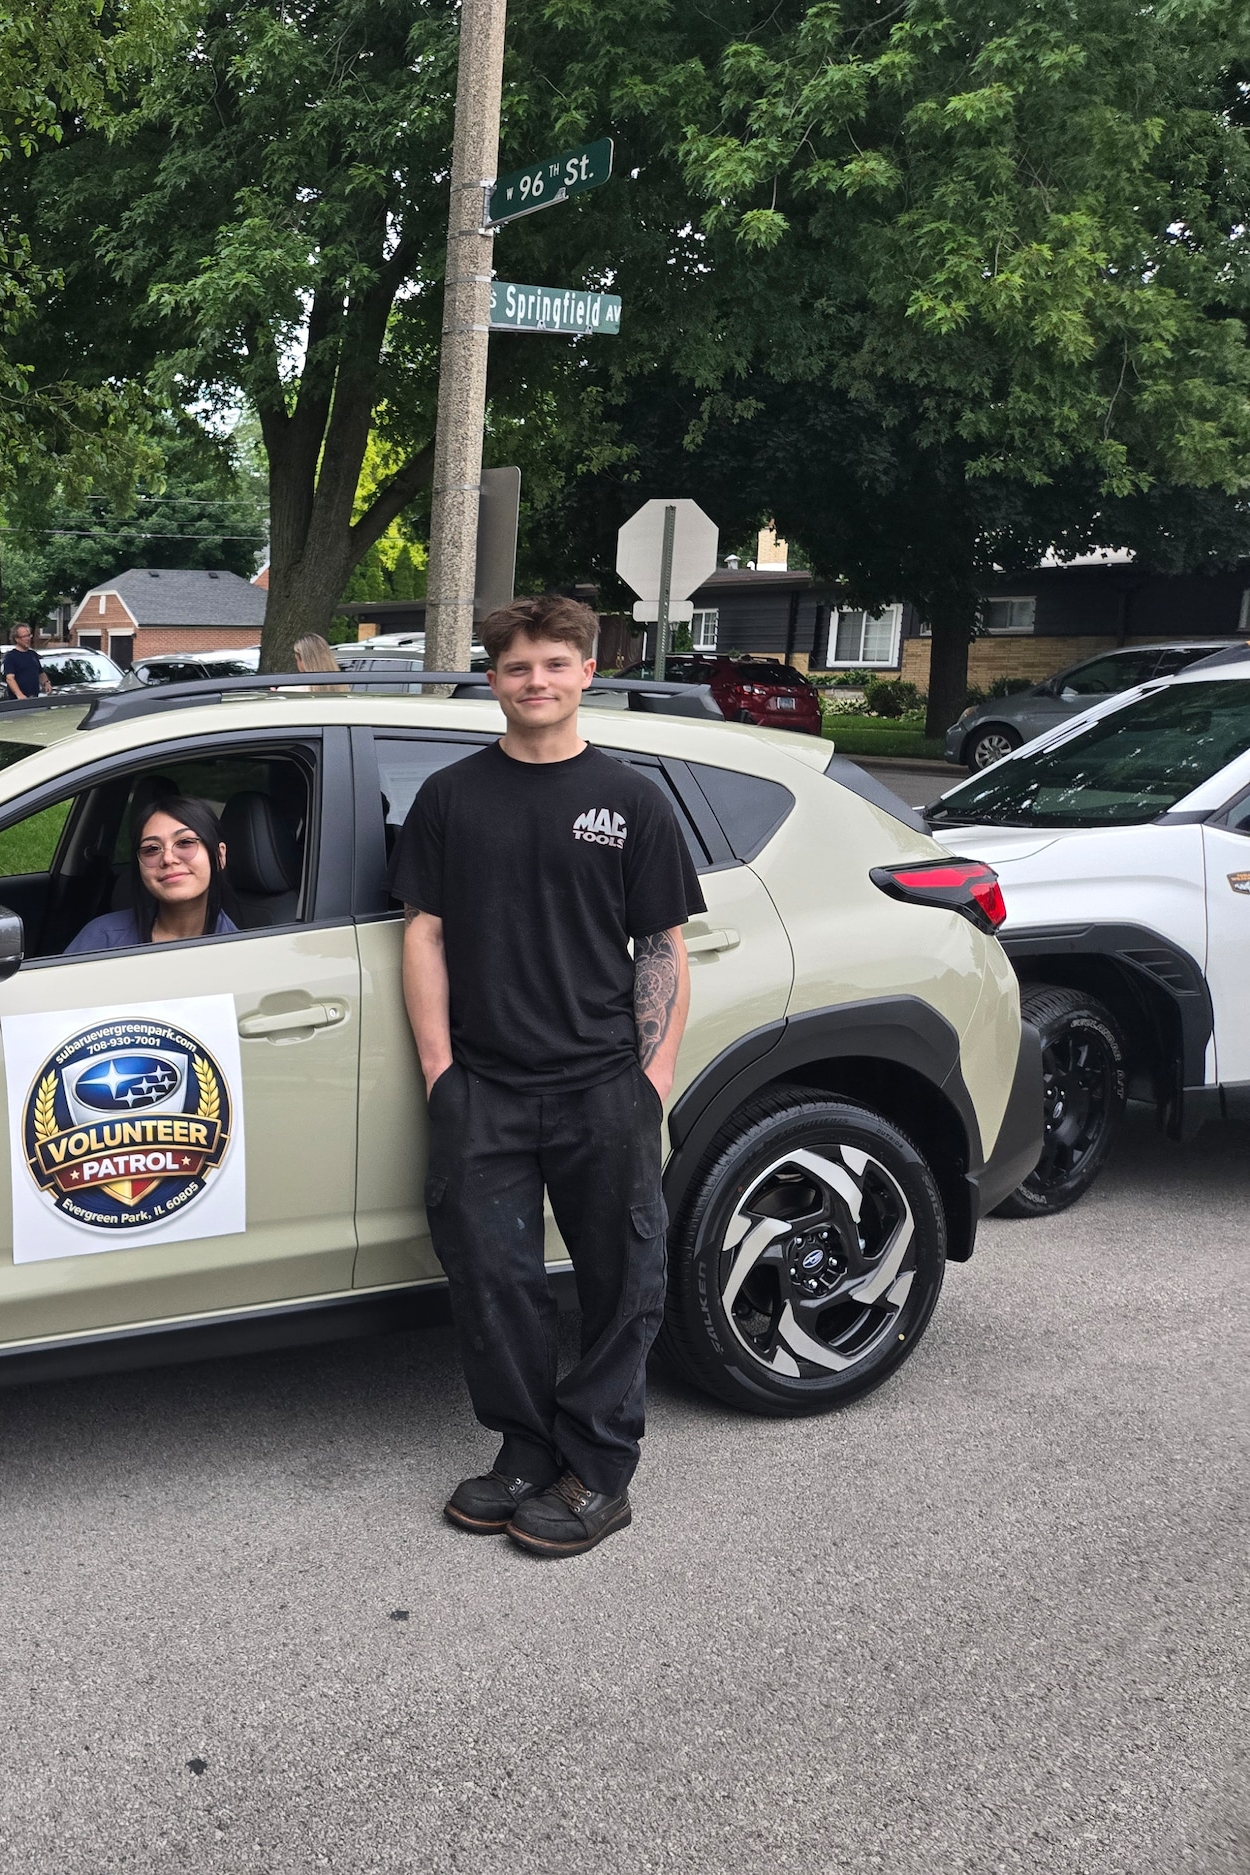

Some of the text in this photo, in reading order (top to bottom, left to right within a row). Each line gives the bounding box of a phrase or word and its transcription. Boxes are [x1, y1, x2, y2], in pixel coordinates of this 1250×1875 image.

[564, 153, 594, 187] St.
[505, 285, 600, 330] Springfield
[605, 304, 622, 322] AV
[572, 808, 628, 840] MAC
[572, 829, 625, 850] TOOLS
[55, 1024, 198, 1065] subaruevergreenpark.com
[86, 1035, 161, 1055] 708-930-7001
[47, 1119, 208, 1164] VOLUNTEER
[82, 1151, 180, 1181] PATROL
[61, 1181, 199, 1224] Evergreen Park, IL 60805
